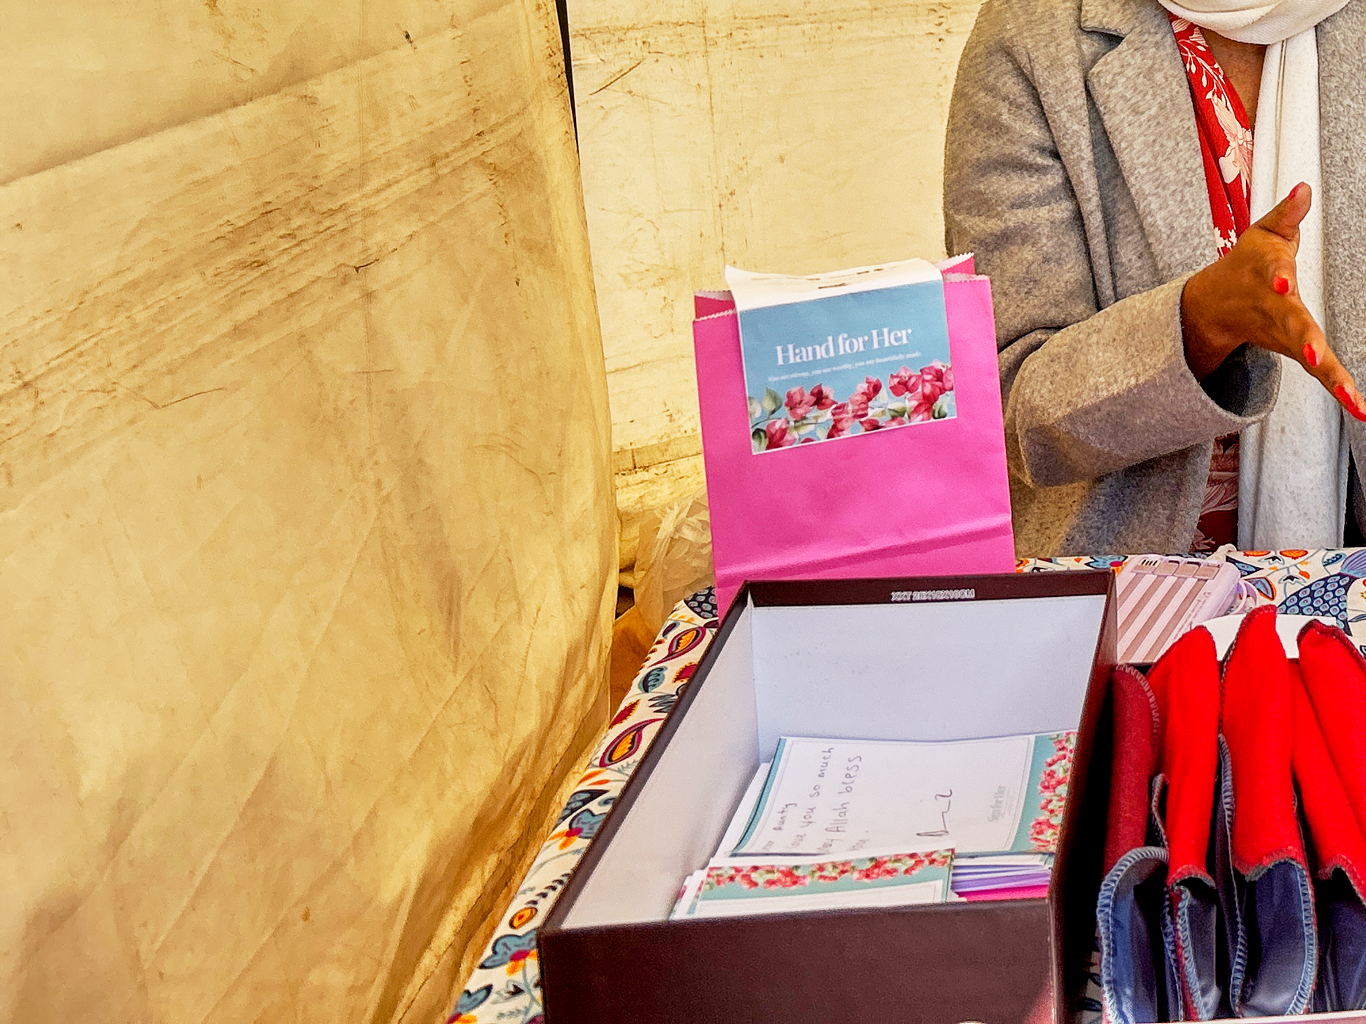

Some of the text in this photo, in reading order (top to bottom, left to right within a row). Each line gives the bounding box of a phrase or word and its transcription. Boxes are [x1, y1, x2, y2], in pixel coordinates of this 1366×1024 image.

[776, 327, 912, 365] Hand for Her
[800, 806, 816, 829] you
[809, 784, 821, 798] so
[818, 746, 835, 778] much
[824, 802, 850, 833] Allah
[837, 755, 862, 795] bless
